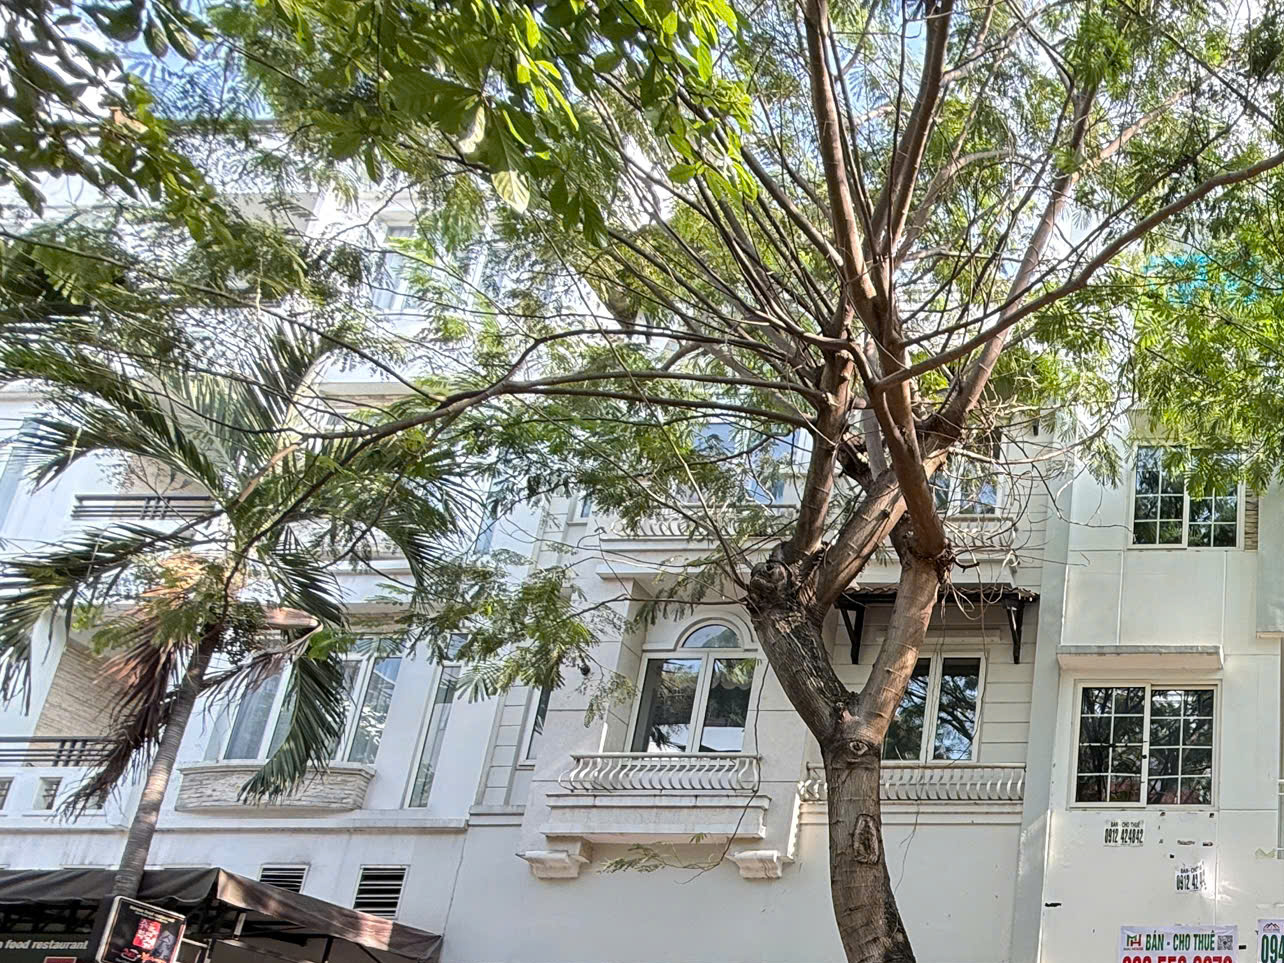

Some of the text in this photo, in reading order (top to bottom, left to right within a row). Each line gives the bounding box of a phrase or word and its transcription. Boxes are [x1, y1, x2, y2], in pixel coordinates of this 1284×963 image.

[5, 939, 32, 950] food
[31, 939, 88, 950] restaurant
[1145, 930, 1215, 951] BÁN CHO THUÊ
